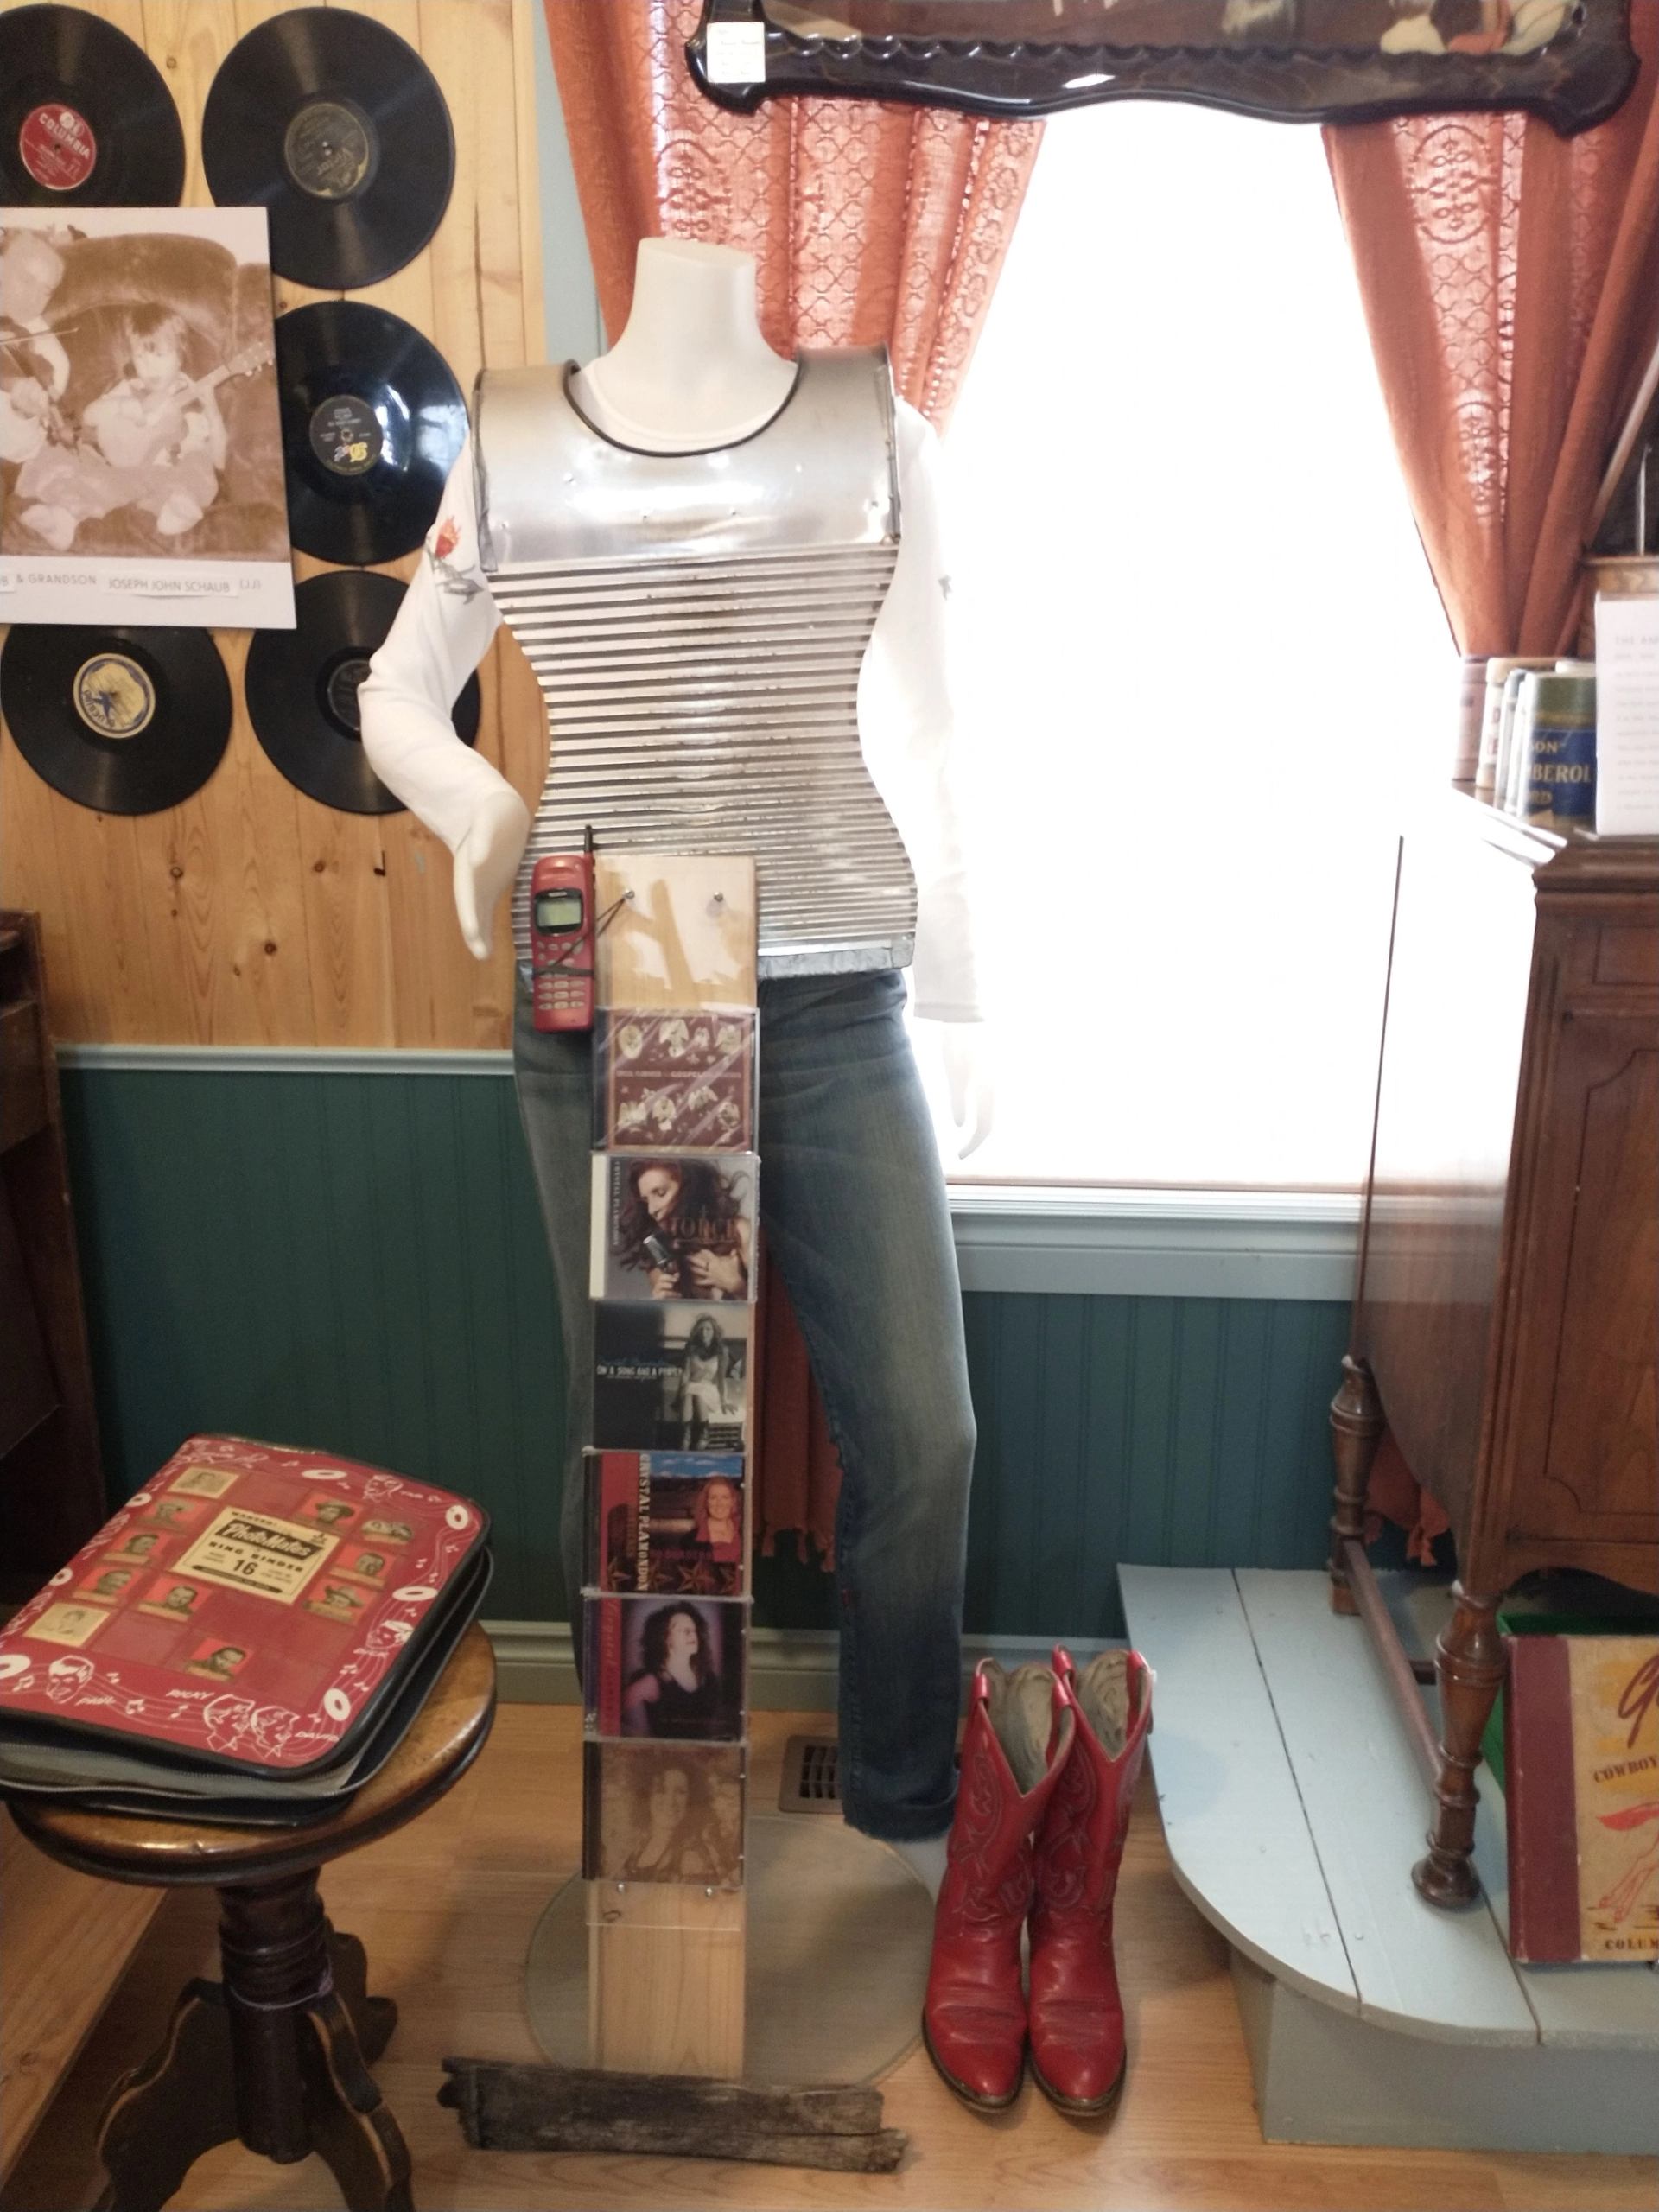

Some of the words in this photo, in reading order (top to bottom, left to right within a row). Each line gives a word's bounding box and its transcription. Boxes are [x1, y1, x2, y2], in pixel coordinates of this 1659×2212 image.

[39, 112, 91, 160] COLUMBIA
[28, 573, 97, 586] GRANDSON
[108, 576, 148, 589] JOSEPH
[150, 578, 181, 591] JOHN
[184, 580, 231, 593] SCHAUB
[639, 1453, 651, 1514] CRYSTAL
[208, 1541, 244, 1554] RING
[251, 1553, 304, 1573] BINDER
[233, 1559, 259, 1576] 16
[637, 1515, 650, 1591] PLAMONDON
[1592, 1756, 1659, 1783] COWBOY
